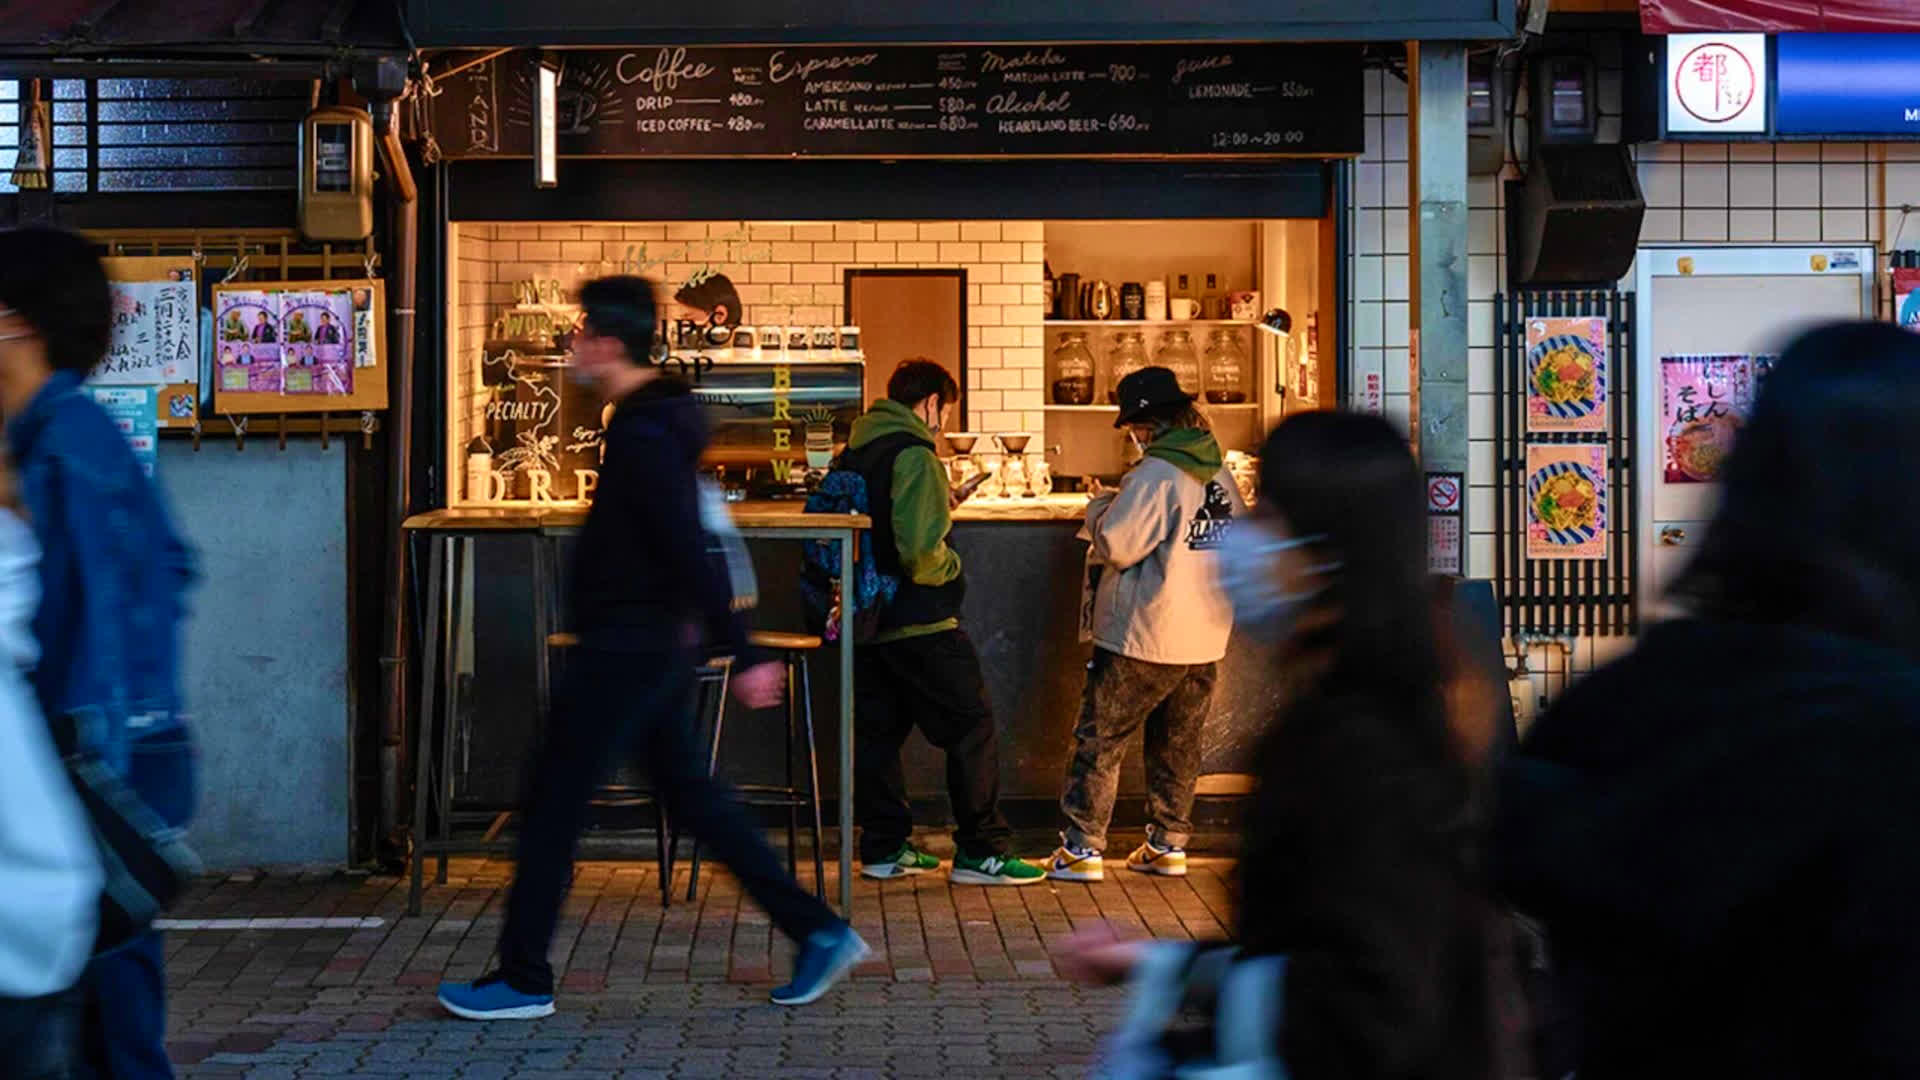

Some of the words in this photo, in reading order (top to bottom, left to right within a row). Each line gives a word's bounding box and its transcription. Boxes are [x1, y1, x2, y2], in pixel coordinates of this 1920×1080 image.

[981, 49, 1066, 73] Matcha
[616, 47, 716, 92] Coffee
[1189, 83, 1252, 99] LEMONADE
[636, 96, 674, 111] DRIP
[804, 99, 848, 112] LATTE
[938, 98, 965, 113] 580
[985, 90, 1072, 114] Alcohol
[667, 117, 712, 132] COFFEE
[938, 115, 967, 130] 680
[998, 119, 1066, 133] HEARTLAND
[1068, 118, 1101, 132] BEER
[1676, 385, 1698, 422] そば
[770, 366, 795, 481] BREW
